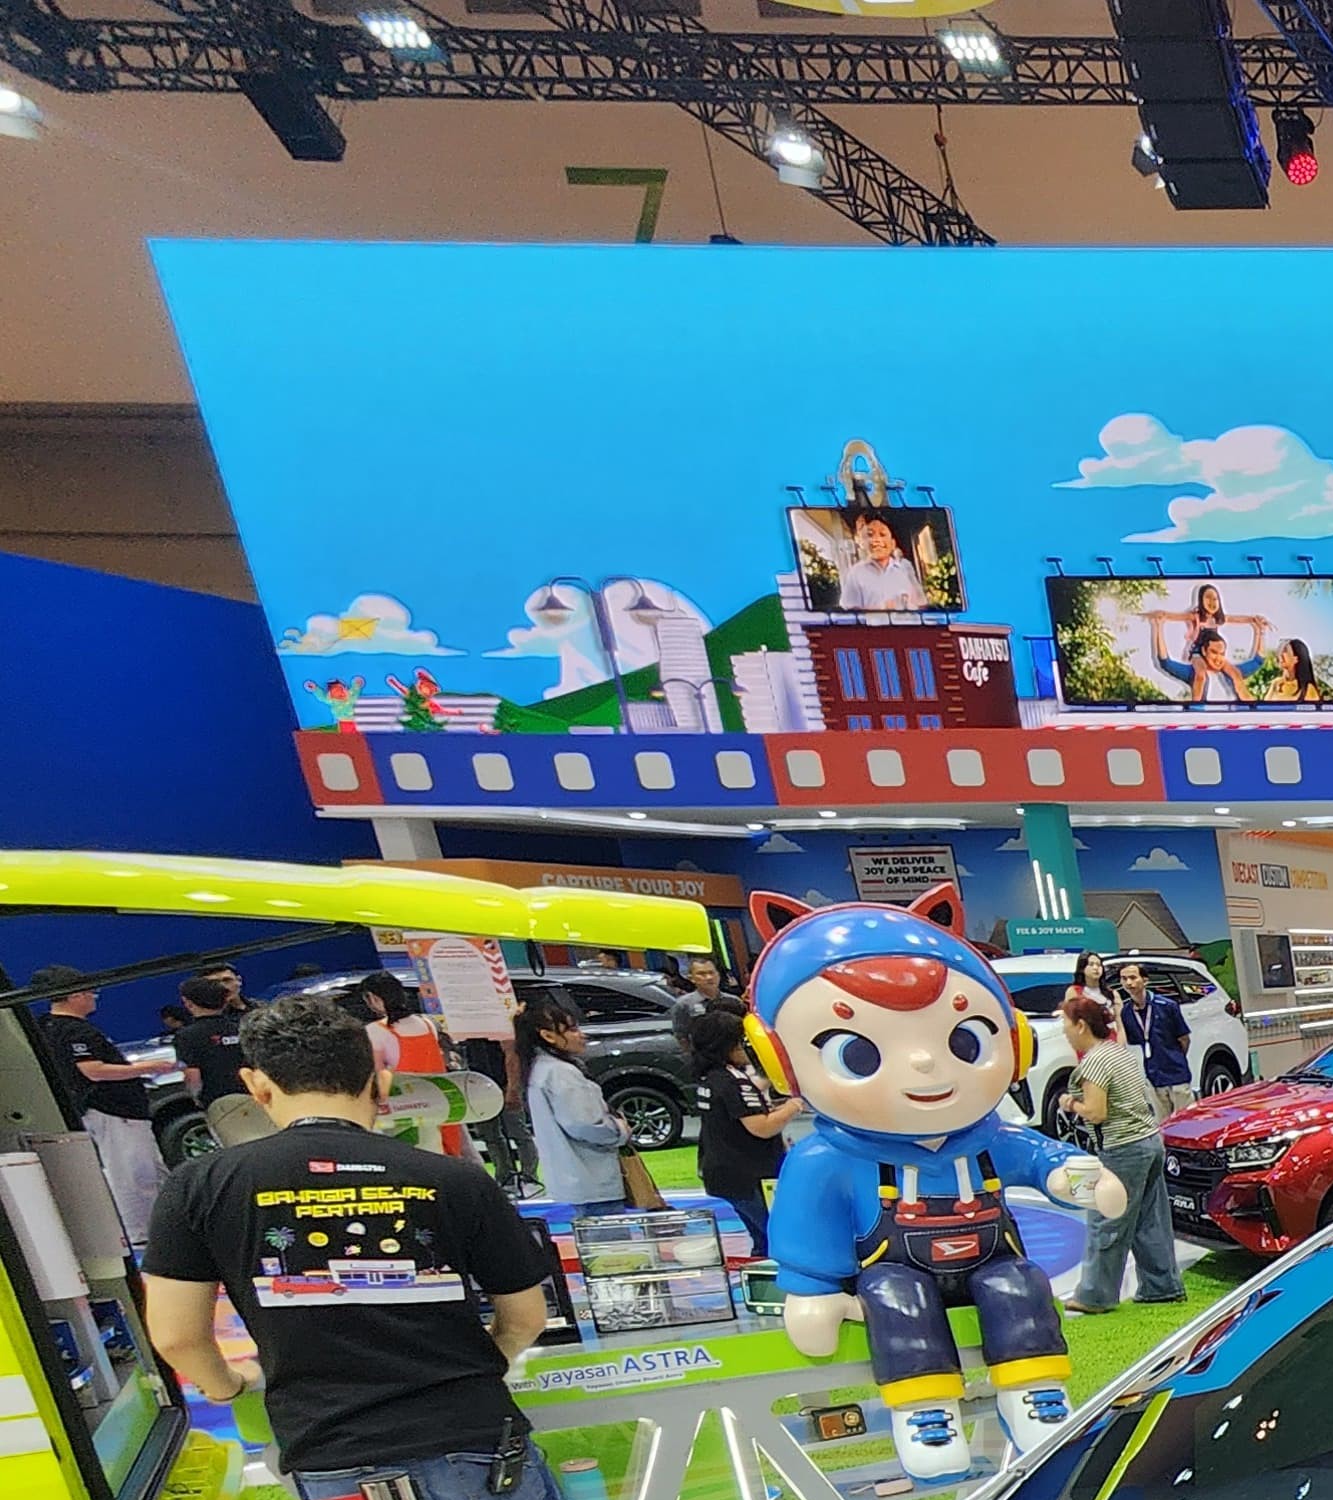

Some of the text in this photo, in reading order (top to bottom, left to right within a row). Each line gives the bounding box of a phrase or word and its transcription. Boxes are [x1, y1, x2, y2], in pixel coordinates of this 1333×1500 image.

[958, 636, 1009, 661] DAIHATSU
[963, 660, 989, 687] Cafe
[871, 856, 935, 865] WE DELIVER
[864, 866, 946, 875] JOY AND PEACE
[886, 876, 929, 884] OF MIND
[628, 878, 674, 895] YOUR
[676, 880, 705, 897] JOY
[257, 1186, 437, 1206] BAHAGIA SEJAK
[296, 1201, 405, 1218] PERTAMA
[539, 1363, 619, 1389] yayasan
[623, 1347, 712, 1374] ASTRA
